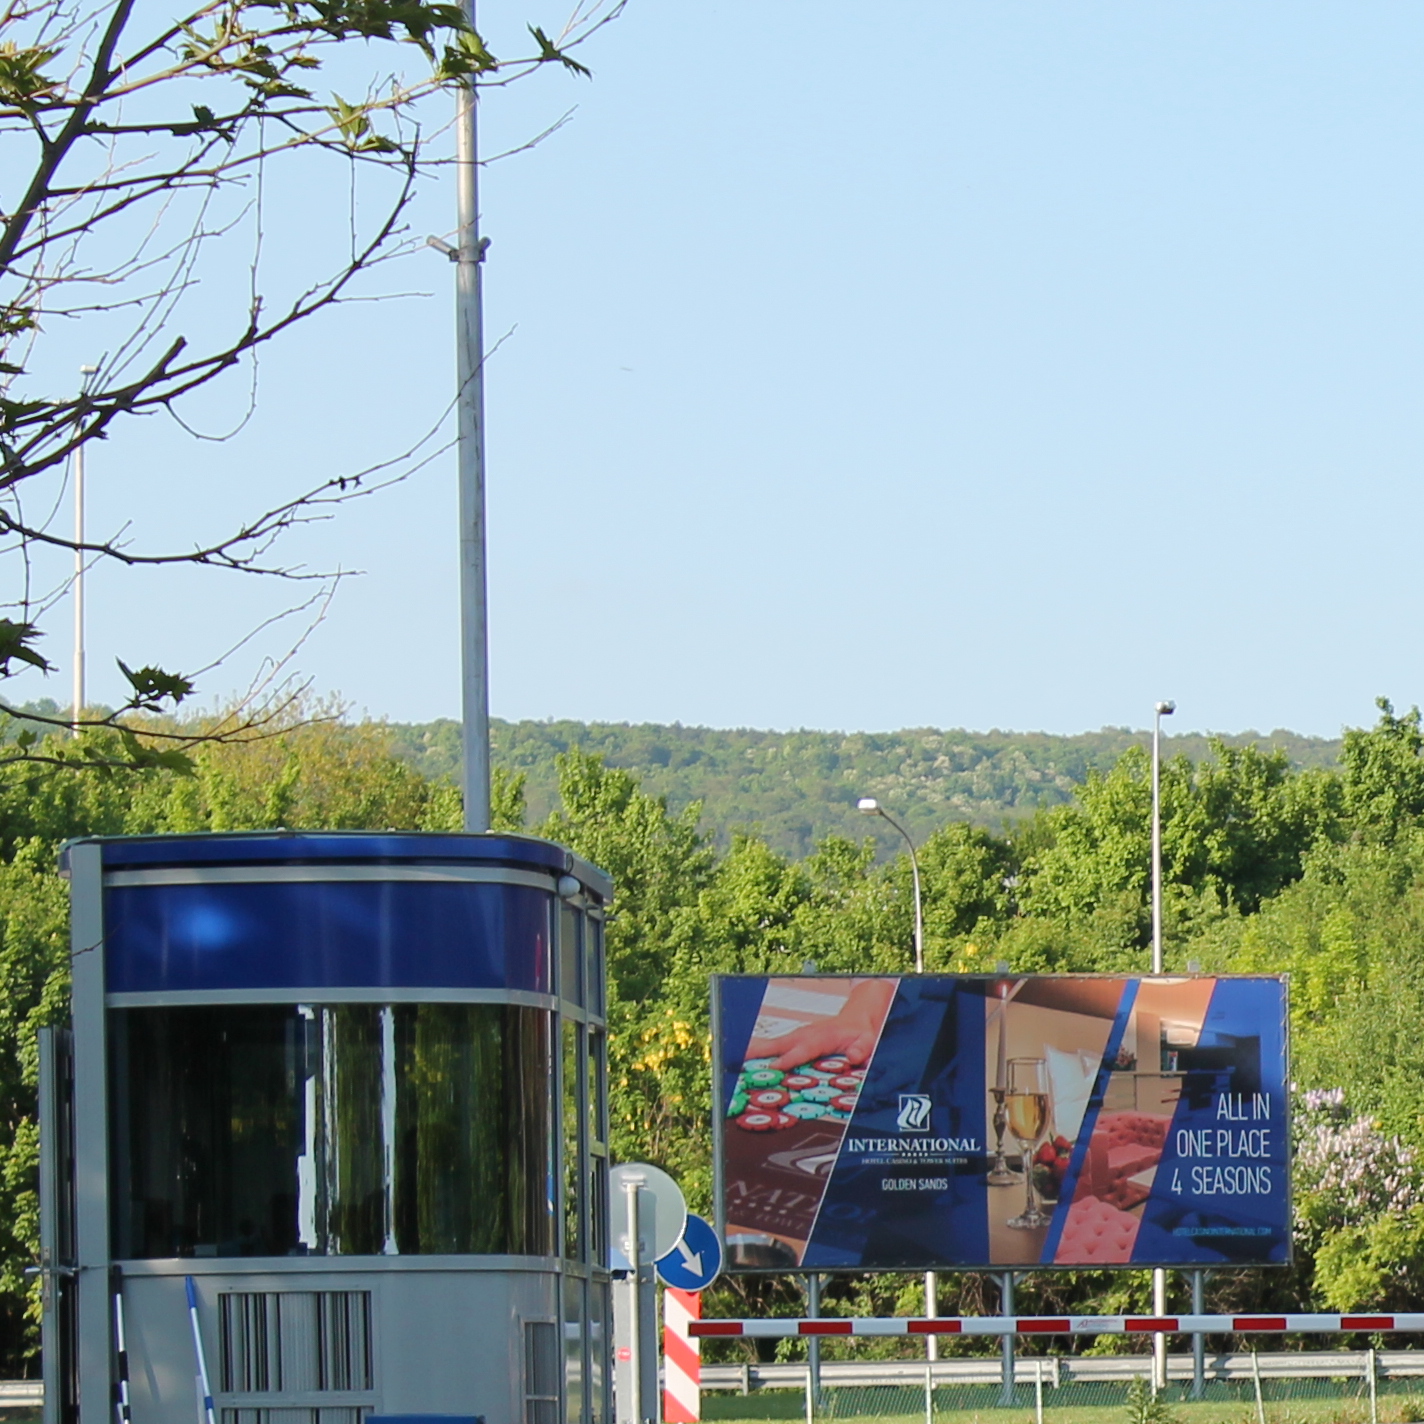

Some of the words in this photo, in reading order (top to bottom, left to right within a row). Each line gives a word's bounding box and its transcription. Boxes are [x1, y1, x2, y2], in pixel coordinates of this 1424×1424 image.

[1216, 1092, 1248, 1120] ALL
[1253, 1092, 1270, 1120] IN
[849, 1137, 981, 1152] INTERNATIONAL
[1176, 1129, 1213, 1158] ONE
[1217, 1129, 1271, 1158] PLACE
[881, 1178, 917, 1191] GOLDEN
[918, 1178, 948, 1191] SANDS
[1171, 1167, 1183, 1195] 4
[1191, 1166, 1272, 1195] SEASONS
